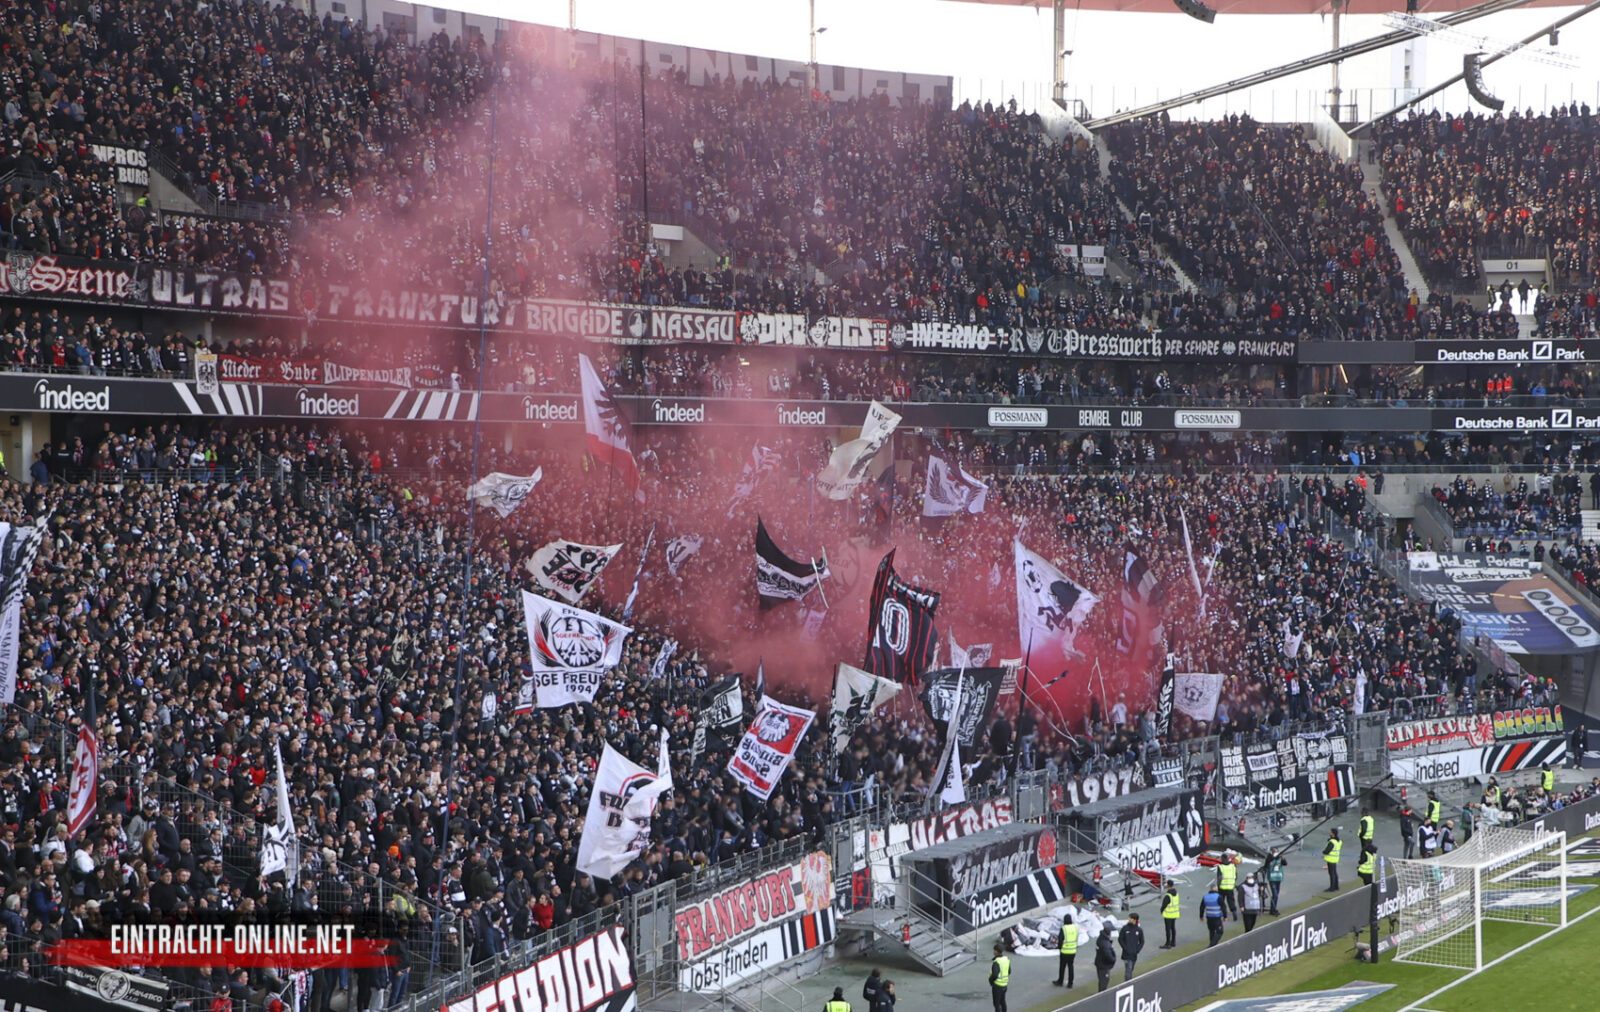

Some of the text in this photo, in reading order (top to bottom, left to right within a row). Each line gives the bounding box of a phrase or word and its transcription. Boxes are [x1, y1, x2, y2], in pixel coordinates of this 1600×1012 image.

[30, 256, 130, 298] Szene
[1506, 261, 1519, 270] 01
[152, 269, 520, 327] ULTRAS FRANKFURT
[527, 303, 733, 342] BRIGADE NASSAU
[912, 322, 990, 350] INFERNO
[1063, 328, 1162, 357] Presswerk
[1165, 340, 1296, 357] PER SEMPRE FRANKFURT
[1438, 348, 1584, 361] Deutsche Bank Park
[323, 361, 412, 389] KLIPPENADLER
[34, 380, 110, 412] indeed
[296, 388, 359, 416] indeed
[522, 396, 578, 421] indeed
[652, 399, 705, 423] indeed
[777, 403, 826, 425] indeed
[994, 411, 1043, 423] POSSMANN
[1079, 409, 1143, 426] BEMBEL CLUB
[1181, 413, 1235, 425] POSSMANN
[1455, 416, 1513, 429] Deutsche
[1516, 416, 1548, 429] Bank
[1420, 591, 1491, 604] SPIELT
[1454, 612, 1527, 625] USIK!
[563, 673, 604, 686] FREU
[565, 684, 592, 694] 1994
[1387, 714, 1479, 743] EINTRACHT
[1416, 756, 1459, 781] indeed
[1067, 766, 1133, 807] 1997
[1259, 782, 1297, 808] finden
[911, 796, 1013, 851] ULTRAS
[675, 867, 796, 961] FRANKFURT
[969, 885, 1018, 927] indeed
[725, 939, 768, 978] finden
[1218, 923, 1328, 989] Deutsche Bank Park
[1137, 991, 1163, 1012] Park
